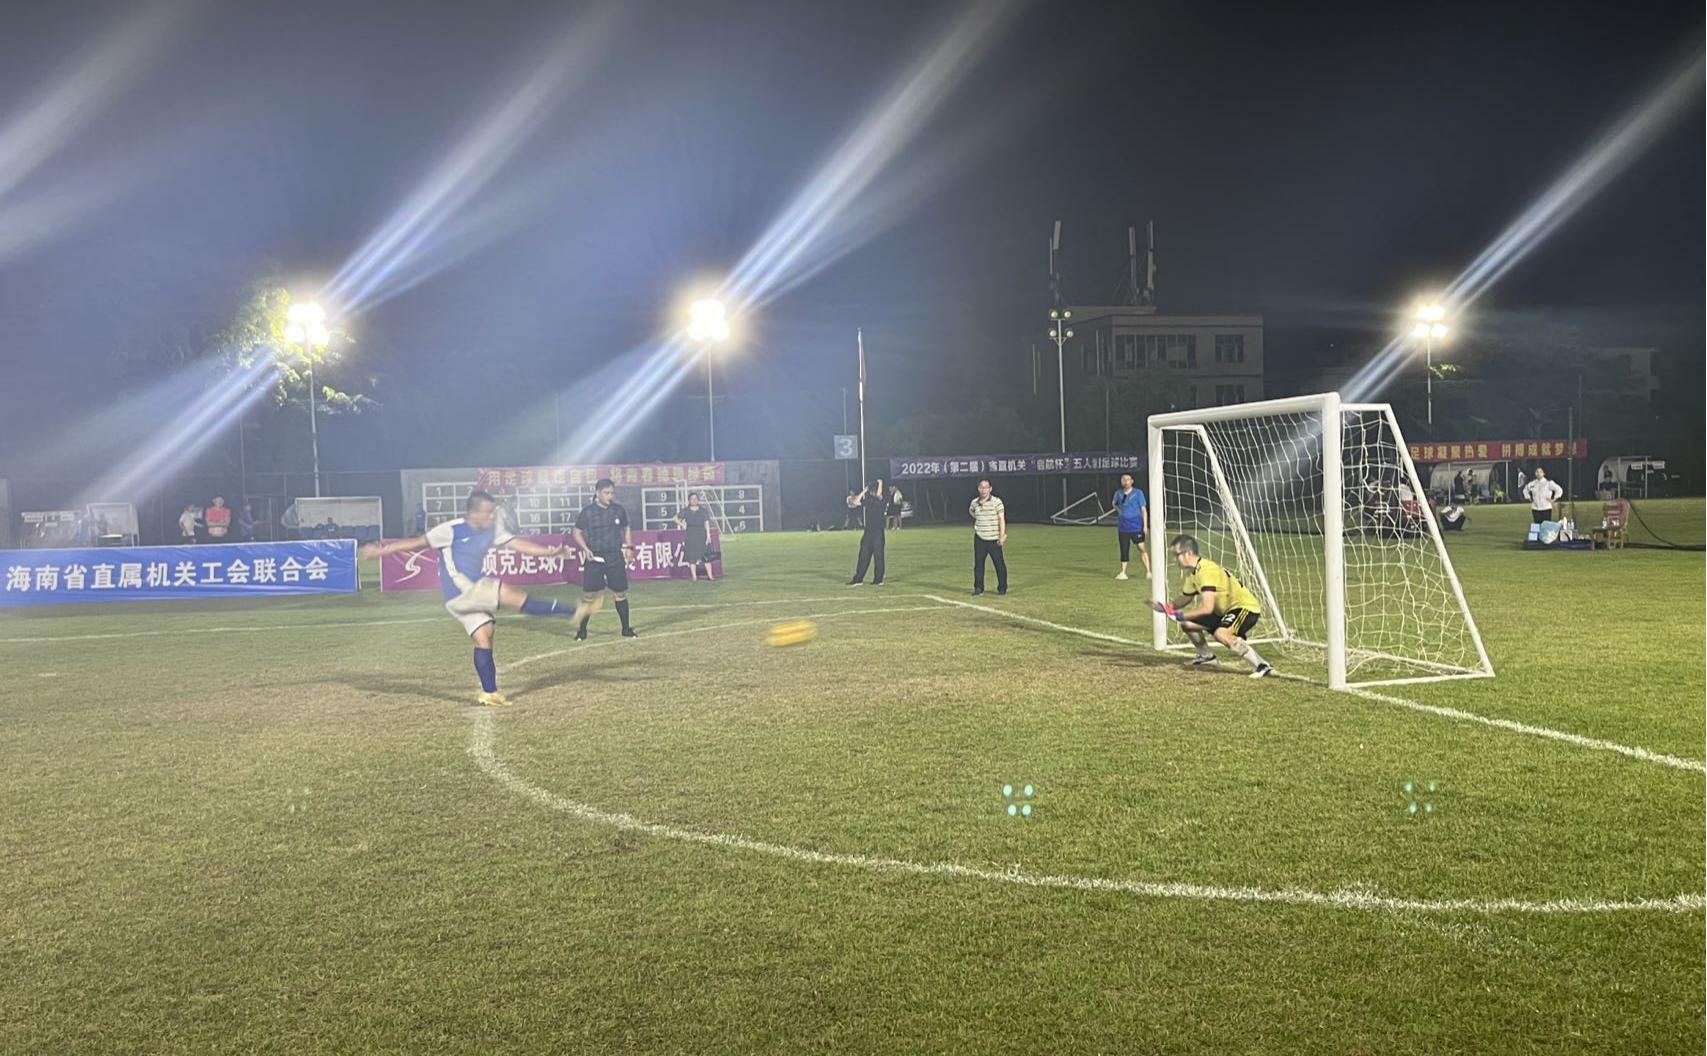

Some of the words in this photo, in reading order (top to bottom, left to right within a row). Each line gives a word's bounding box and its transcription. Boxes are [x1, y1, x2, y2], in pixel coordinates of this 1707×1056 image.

[840, 438, 852, 456] 3
[660, 506, 668, 517] 5
[5, 555, 330, 593] 海南省直属机关工会联合会
